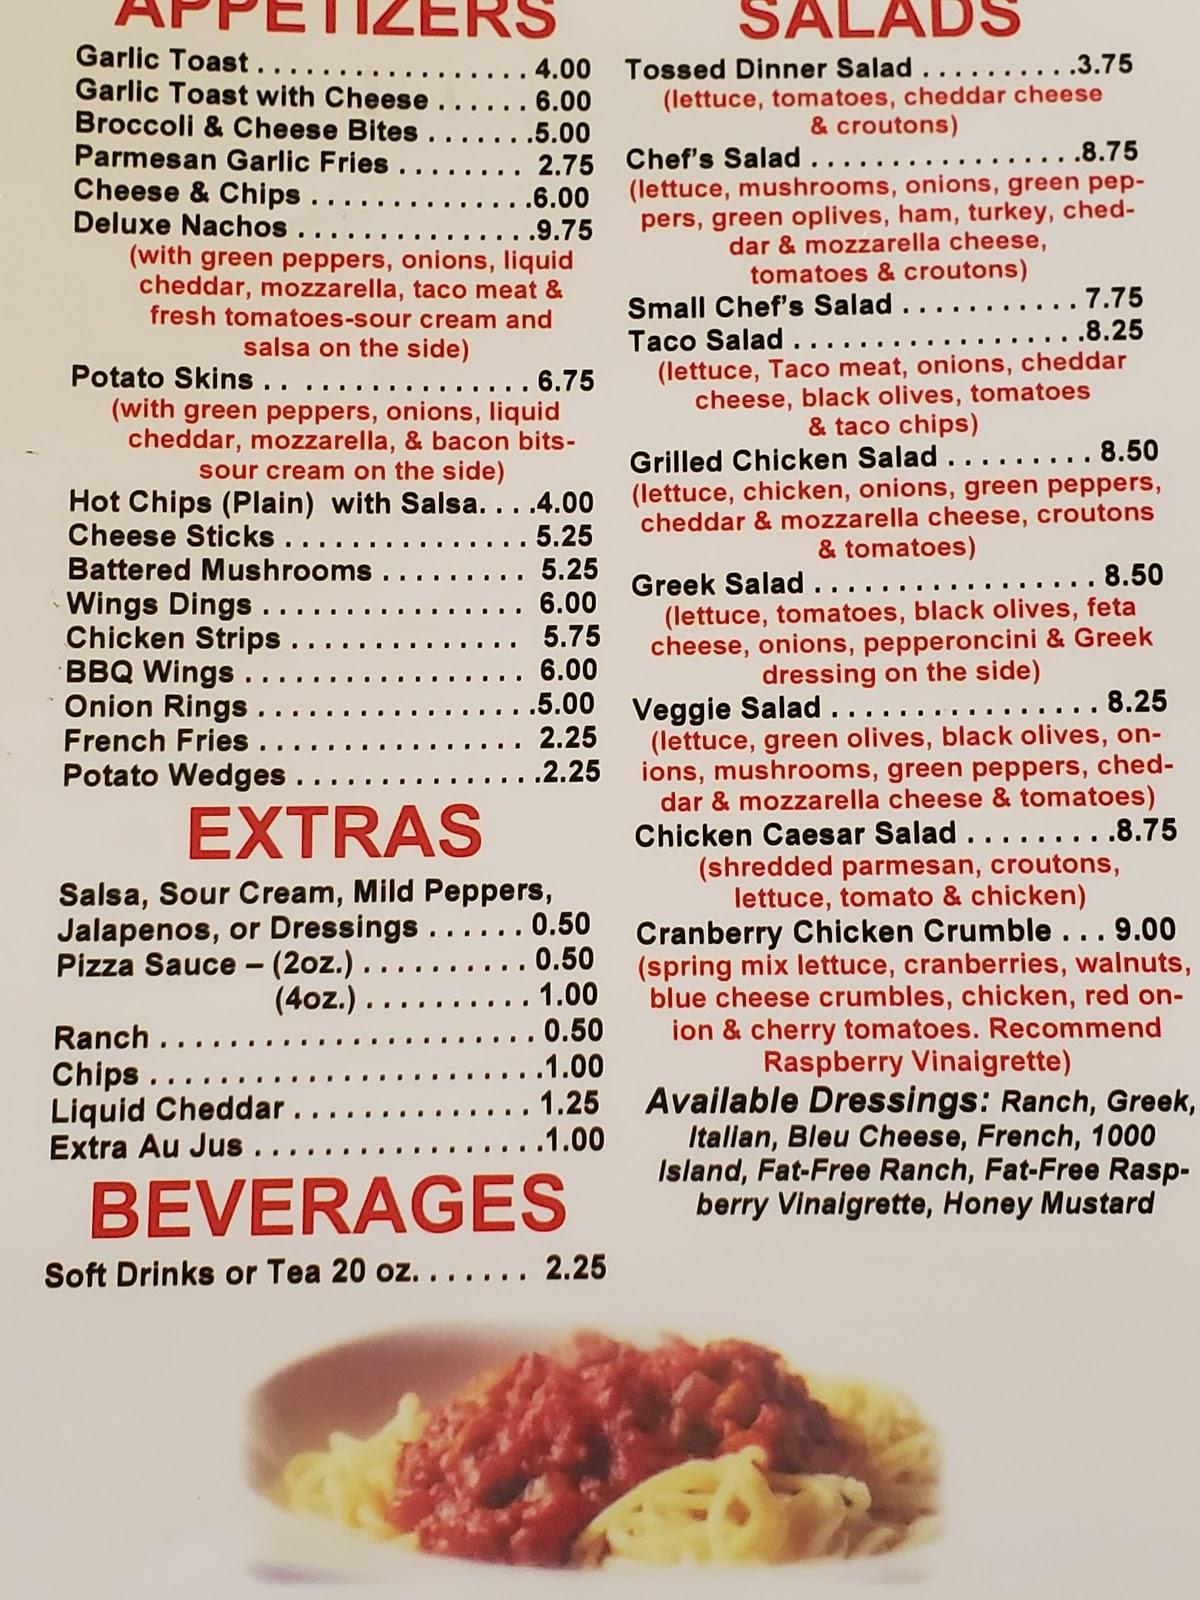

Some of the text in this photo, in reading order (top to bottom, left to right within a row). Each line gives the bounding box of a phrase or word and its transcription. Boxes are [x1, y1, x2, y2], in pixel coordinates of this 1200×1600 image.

[738, 0, 1022, 41] SALADS
[76, 43, 591, 80] Garlic Toast 4.00
[624, 56, 912, 81] Tossed Dinner Salad
[75, 77, 592, 112] Garlic Toast with Cheese 6.00
[663, 84, 1103, 113] (lettuce, tomatoes, cheddar cheese
[75, 143, 594, 177] Parmesan Garlic Fries 2.75
[129, 243, 574, 276] (with green peppers, onions, liquid
[728, 230, 1047, 256] dar & mozzarella cheese,
[149, 304, 552, 330] fresh tomatoes-sour cream and
[71, 363, 595, 393] Potato Skins 6.75
[658, 350, 1128, 386] (lettuce, Taco meat, onions, cheddar
[128, 427, 576, 455] cheddar, mozzarella, & bacon bits-
[629, 438, 1159, 474] Grilled Chicken Salad 8.50
[640, 502, 1155, 533] cheddar & mozzarella cheese, croutons
[68, 522, 593, 548] Cheese Sticks 5.25
[68, 556, 599, 582] Battered Mushrooms 5.25
[631, 562, 1164, 597] Greek Salad 8.50
[66, 590, 597, 622] Wings Dings 6.00
[66, 623, 601, 656] Chicken Strips 5.75
[650, 625, 1154, 659] cheese, onions, pepperoncini & Greek
[66, 657, 598, 690] BBQ Wings 6.00
[762, 658, 1041, 689] dressing on the side)
[631, 688, 1168, 727] Veggie Salad 8.25
[64, 724, 598, 753] French Fries 2.25
[642, 752, 1174, 785] ions, mushrooms, green peppers, ched-
[188, 803, 482, 861] EXTRAS
[699, 853, 1120, 884] (shredded parmesan, croutons,
[58, 877, 552, 911] Salsa, Sour Cream, Mild Peppers,
[56, 911, 591, 948] Jalapenos, or Dressings 0.50
[636, 916, 1176, 951] Cranberry Chicken Crumble 9.00
[638, 951, 1191, 983] (spring mix lettuce, cranberries, walnuts,
[275, 981, 598, 1017] (4oz.) 1.00
[54, 1017, 604, 1051] Ranch 0.50
[672, 1015, 1162, 1046] ion & cherry tomatoes. Recommend
[764, 1048, 1071, 1079] Raspberry Vinaigrette)
[51, 1089, 600, 1130] Liquid Cheddar 1.25
[644, 1084, 1196, 1121] Available Dressings: Ranch, Greek,
[688, 1123, 1156, 1153] Italian, Bleu Cheese, French, 1000
[91, 1172, 567, 1240] BEVERAGES
[696, 1189, 1156, 1222] berry Vinaigrette, Honey Mustard
[44, 1261, 108, 1289] Soft
[116, 1259, 215, 1288] Drinks
[225, 1264, 258, 1286] or
[266, 1257, 321, 1285] Tea
[331, 1256, 366, 1284] 20
[545, 1253, 607, 1281] 2.25
